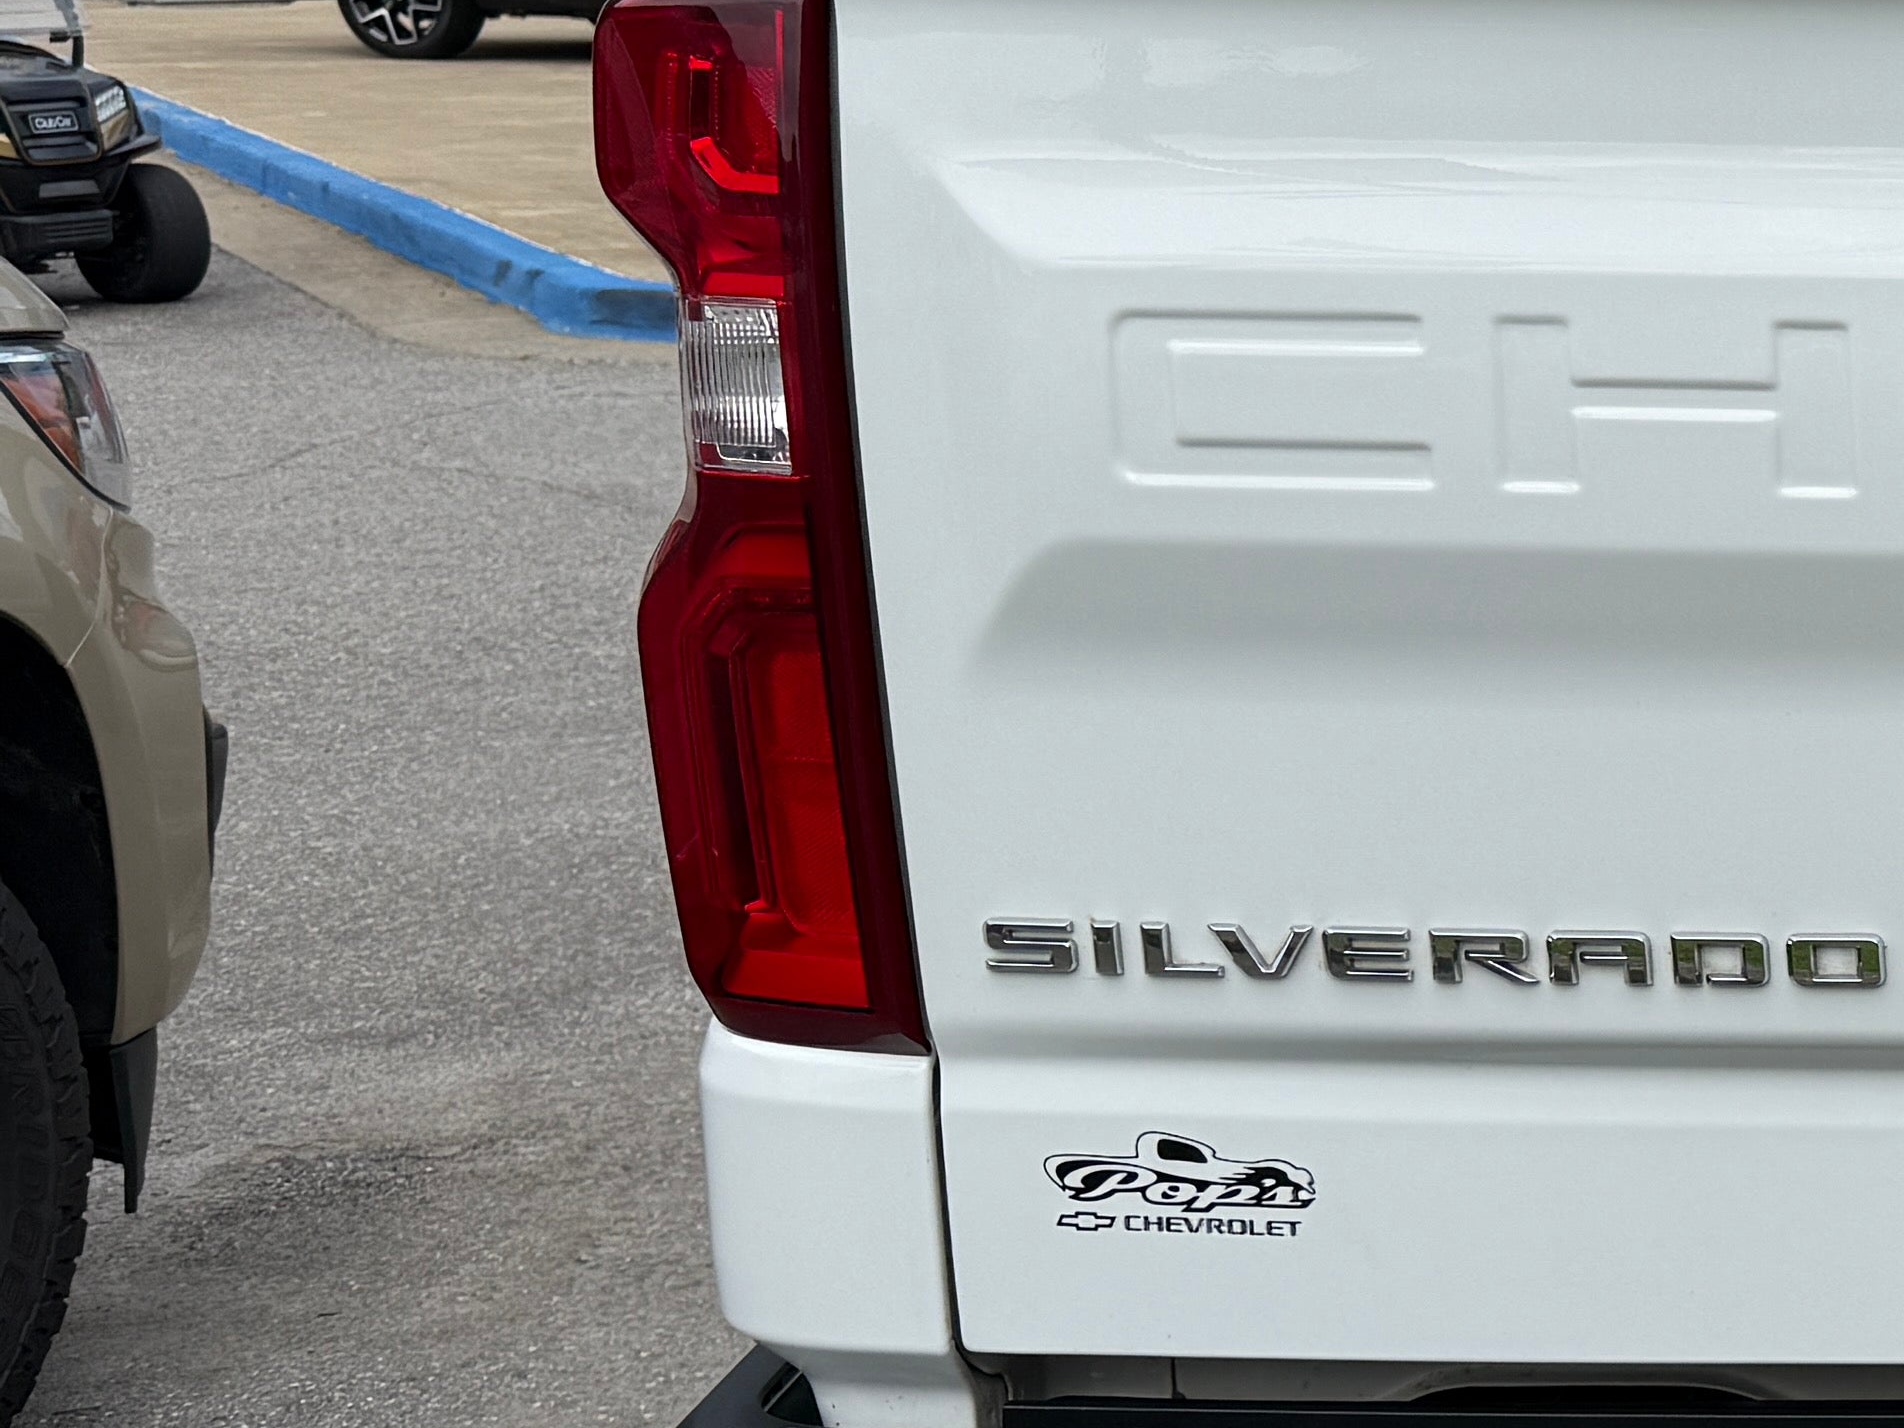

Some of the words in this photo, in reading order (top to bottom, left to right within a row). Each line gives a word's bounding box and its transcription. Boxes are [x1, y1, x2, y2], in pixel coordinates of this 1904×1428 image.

[982, 916, 1887, 990] SILVERADO
[1062, 1163, 1303, 1212] Pop's
[1124, 1214, 1302, 1237] CHEVROLET
